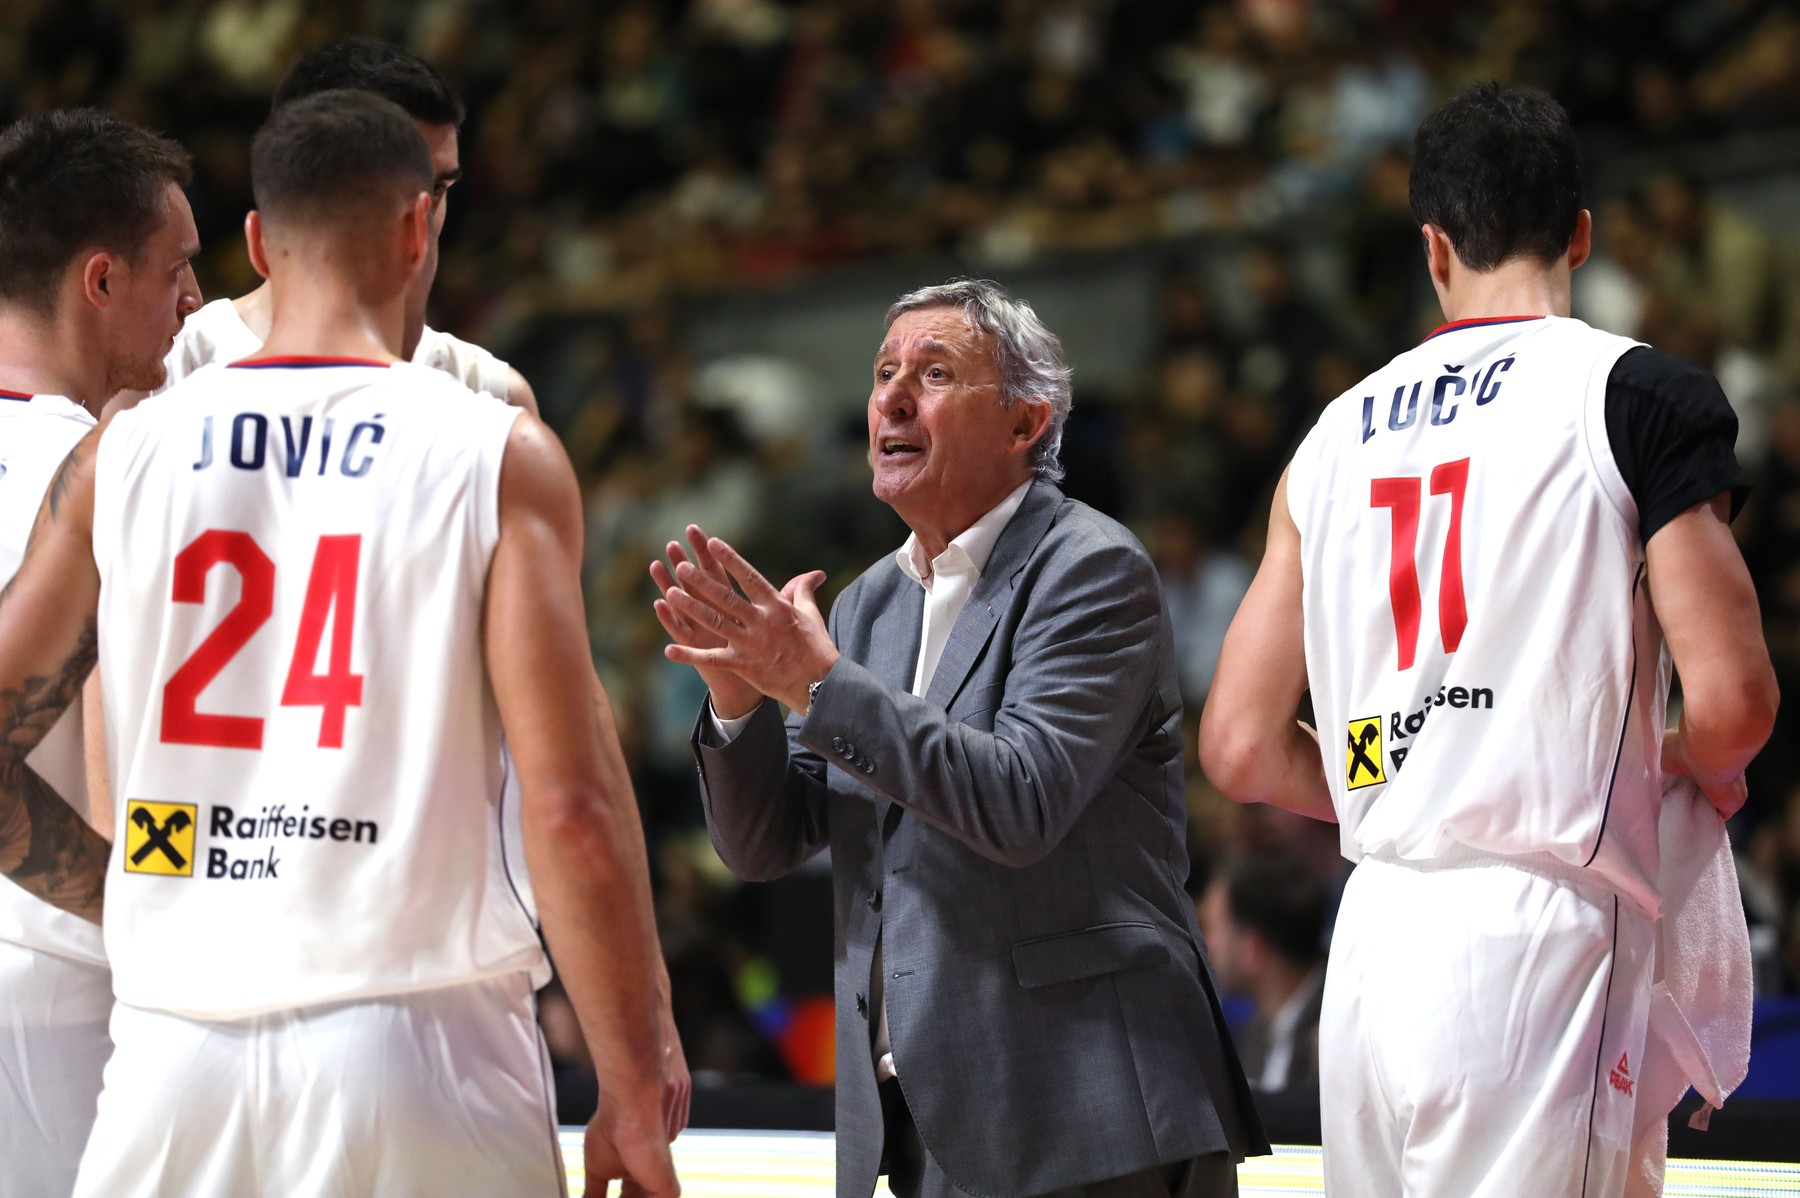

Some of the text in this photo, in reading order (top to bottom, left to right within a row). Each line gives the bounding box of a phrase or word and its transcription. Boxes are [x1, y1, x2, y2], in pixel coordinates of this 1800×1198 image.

[193, 412, 385, 478] JOVIĆ
[1370, 457, 1471, 672] 11
[160, 528, 363, 750] 24
[209, 804, 378, 844] Raiffeisen
[206, 845, 280, 880] Bank
